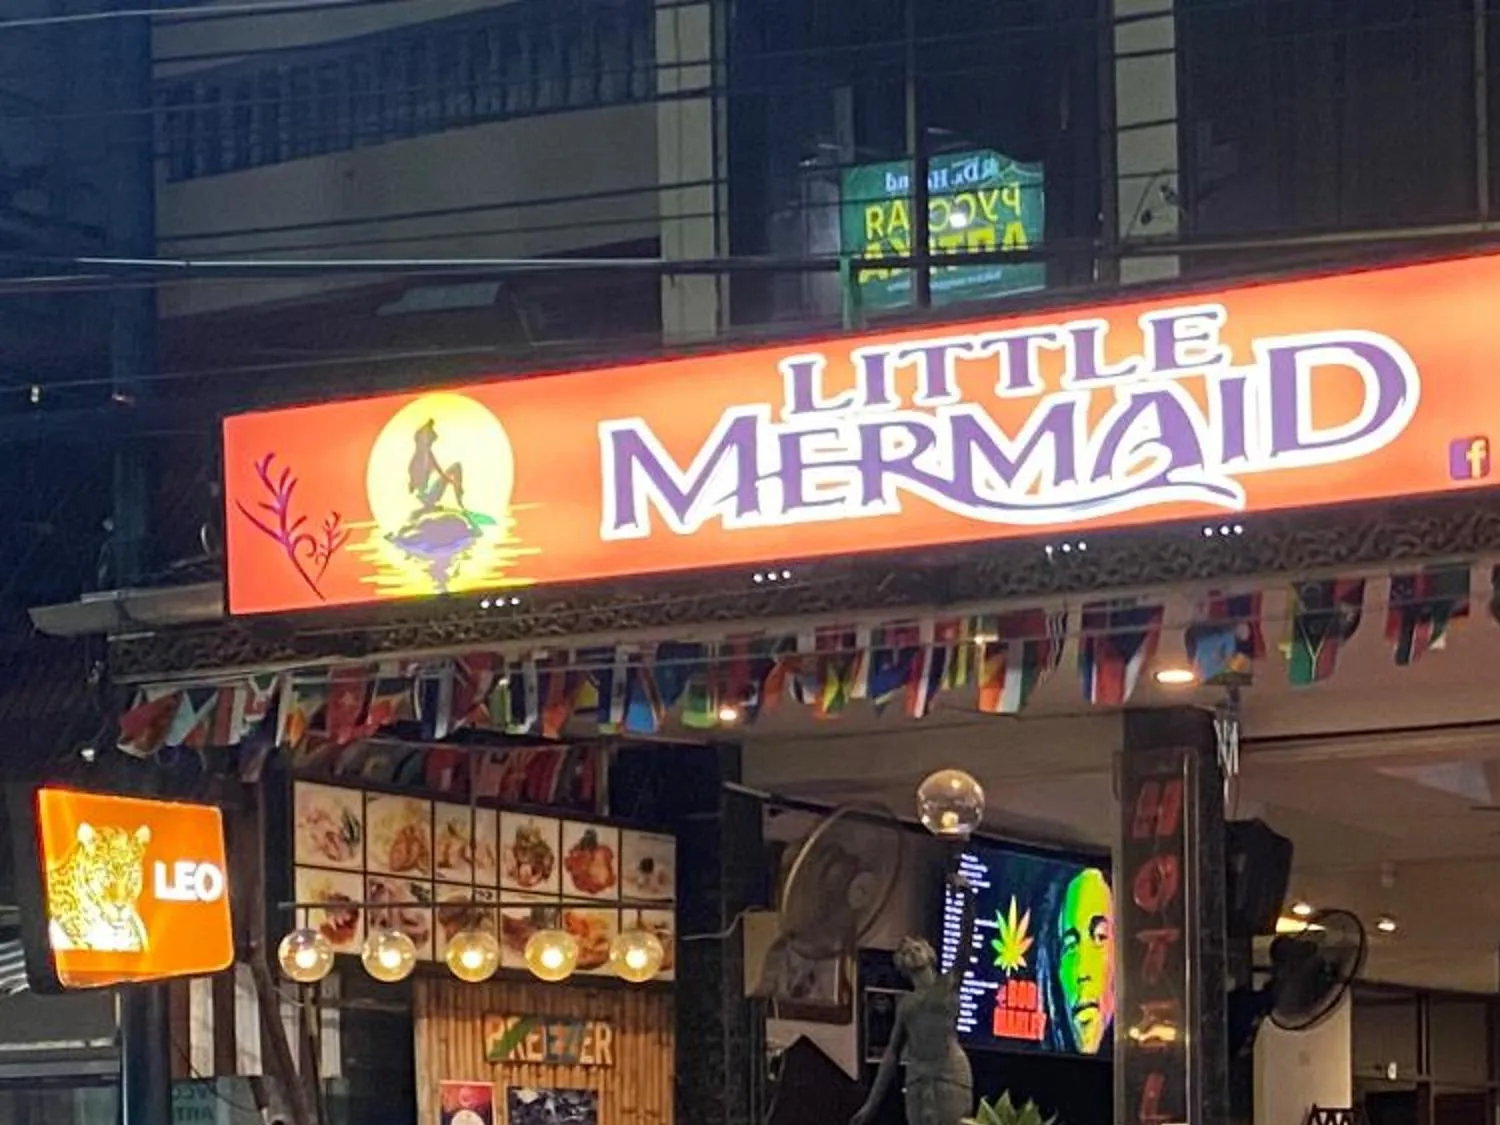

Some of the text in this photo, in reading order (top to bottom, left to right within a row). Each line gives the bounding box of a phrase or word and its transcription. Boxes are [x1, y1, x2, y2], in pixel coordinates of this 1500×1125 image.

[785, 305, 1228, 420] LITTLE
[603, 333, 1417, 538] MERMAID
[154, 860, 223, 903] LEO
